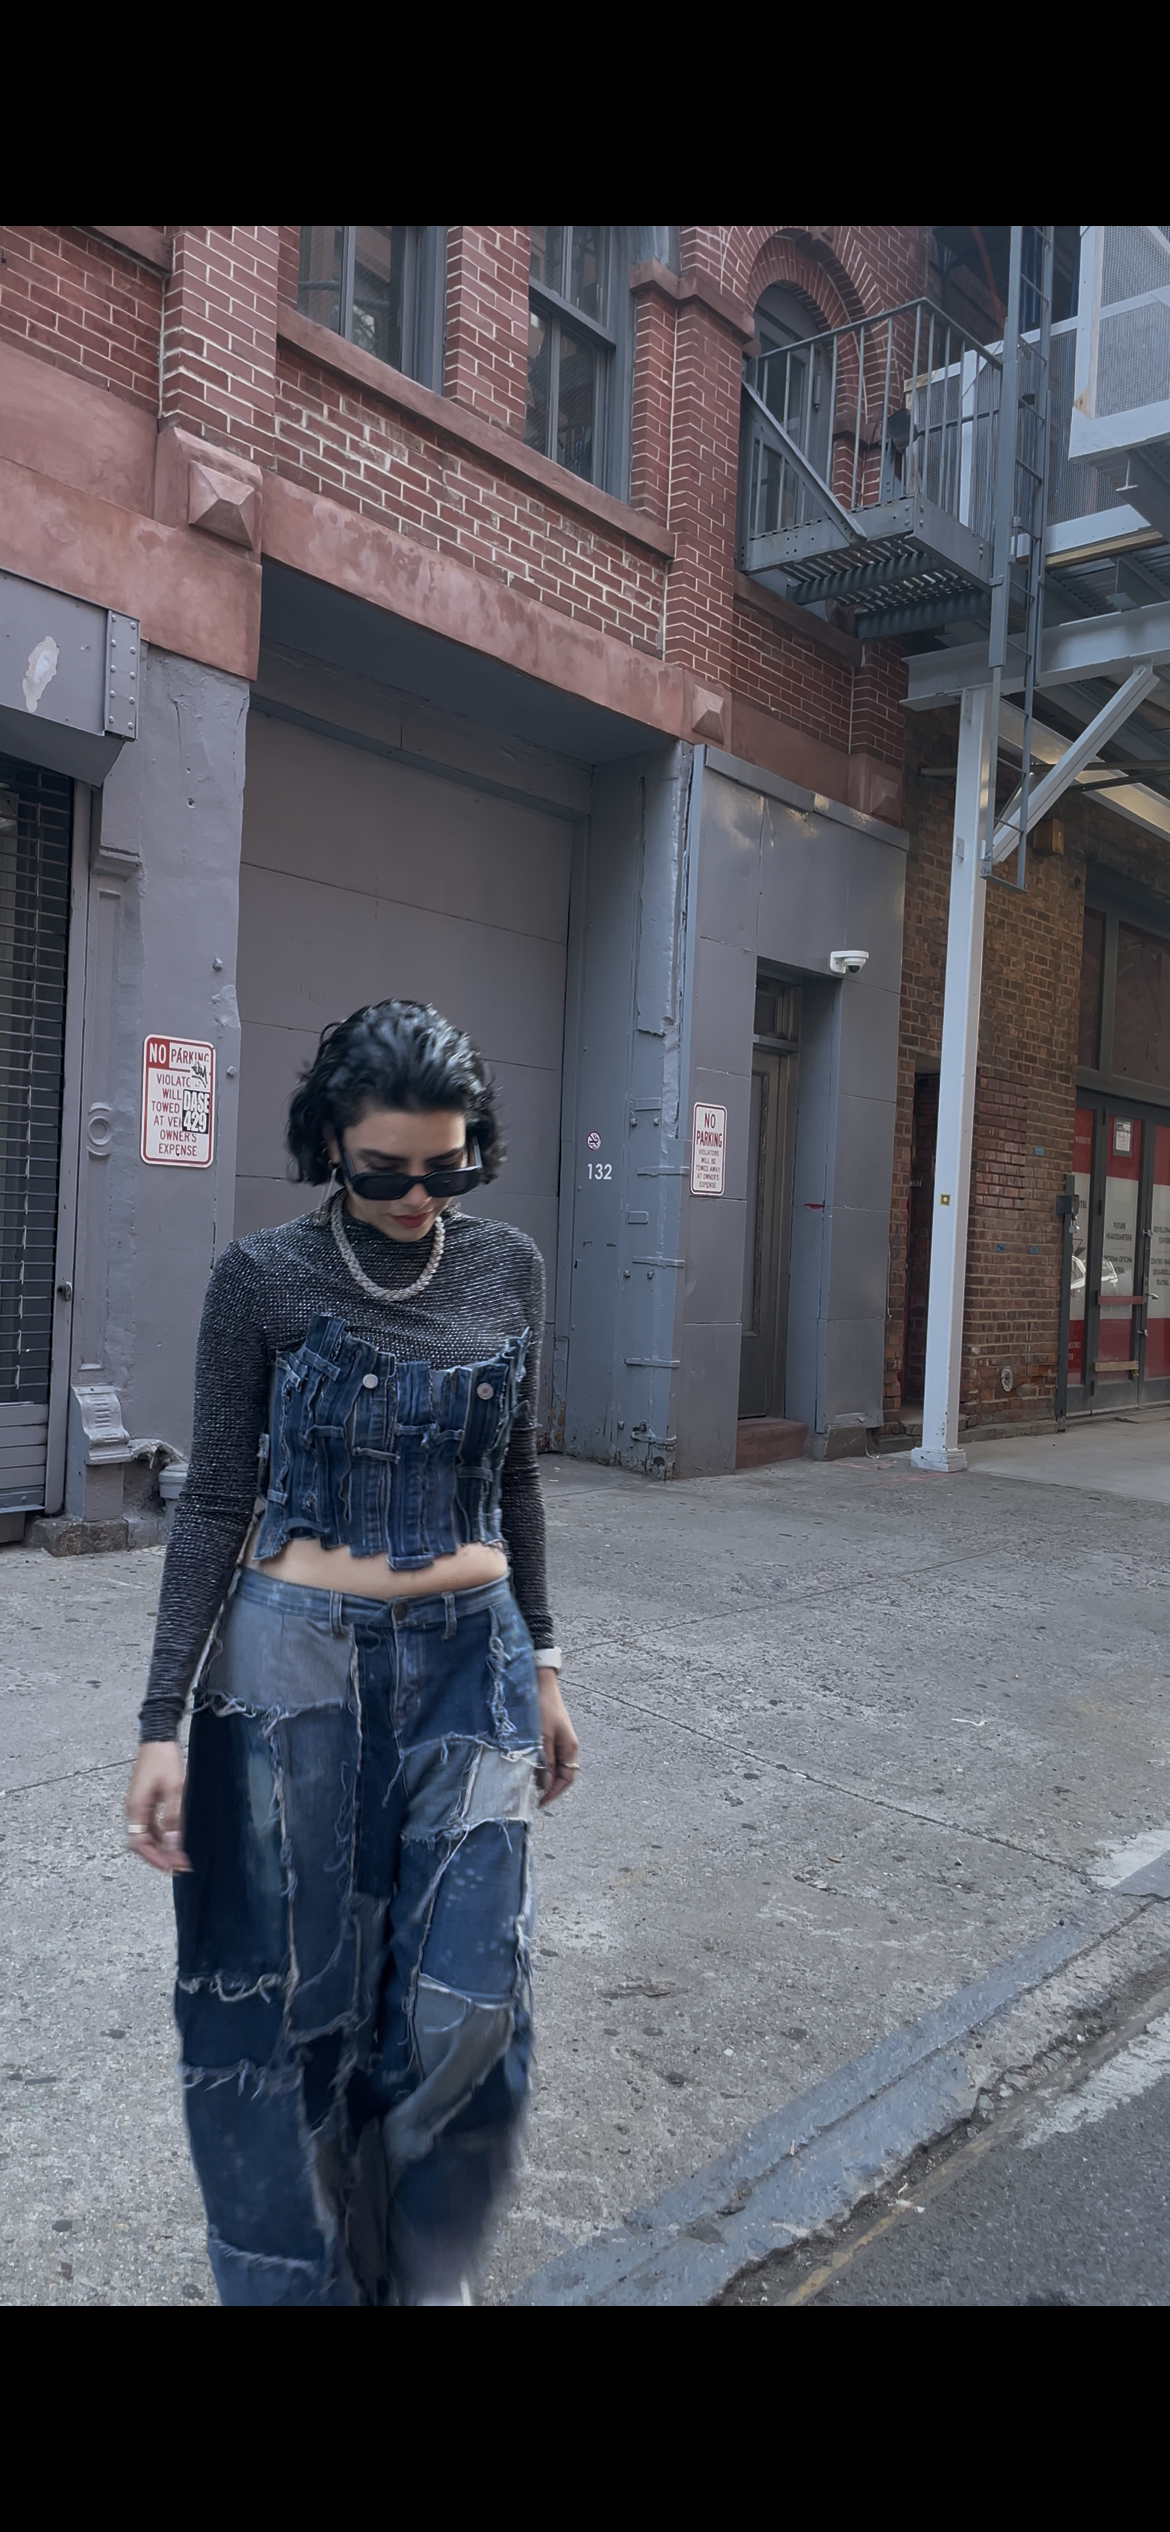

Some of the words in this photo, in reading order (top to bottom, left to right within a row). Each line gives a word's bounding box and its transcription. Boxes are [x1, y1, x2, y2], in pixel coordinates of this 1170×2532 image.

[149, 1043, 167, 1064] NO
[162, 1088, 182, 1101] WILL
[151, 1100, 180, 1114] TOWED
[153, 1115, 164, 1126] AT
[183, 1111, 207, 1133] 429
[704, 1113, 716, 1129] NO
[696, 1130, 723, 1148] PARKING
[158, 1143, 198, 1157] EXPENSE
[698, 1149, 720, 1157] VIOLATORS
[701, 1157, 710, 1165] WILL
[587, 1163, 613, 1180] 132
[696, 1164, 709, 1173] TOWED
[709, 1165, 721, 1173] AWAY
[697, 1172, 703, 1180] AT
[699, 1181, 717, 1189] EXPENSE
